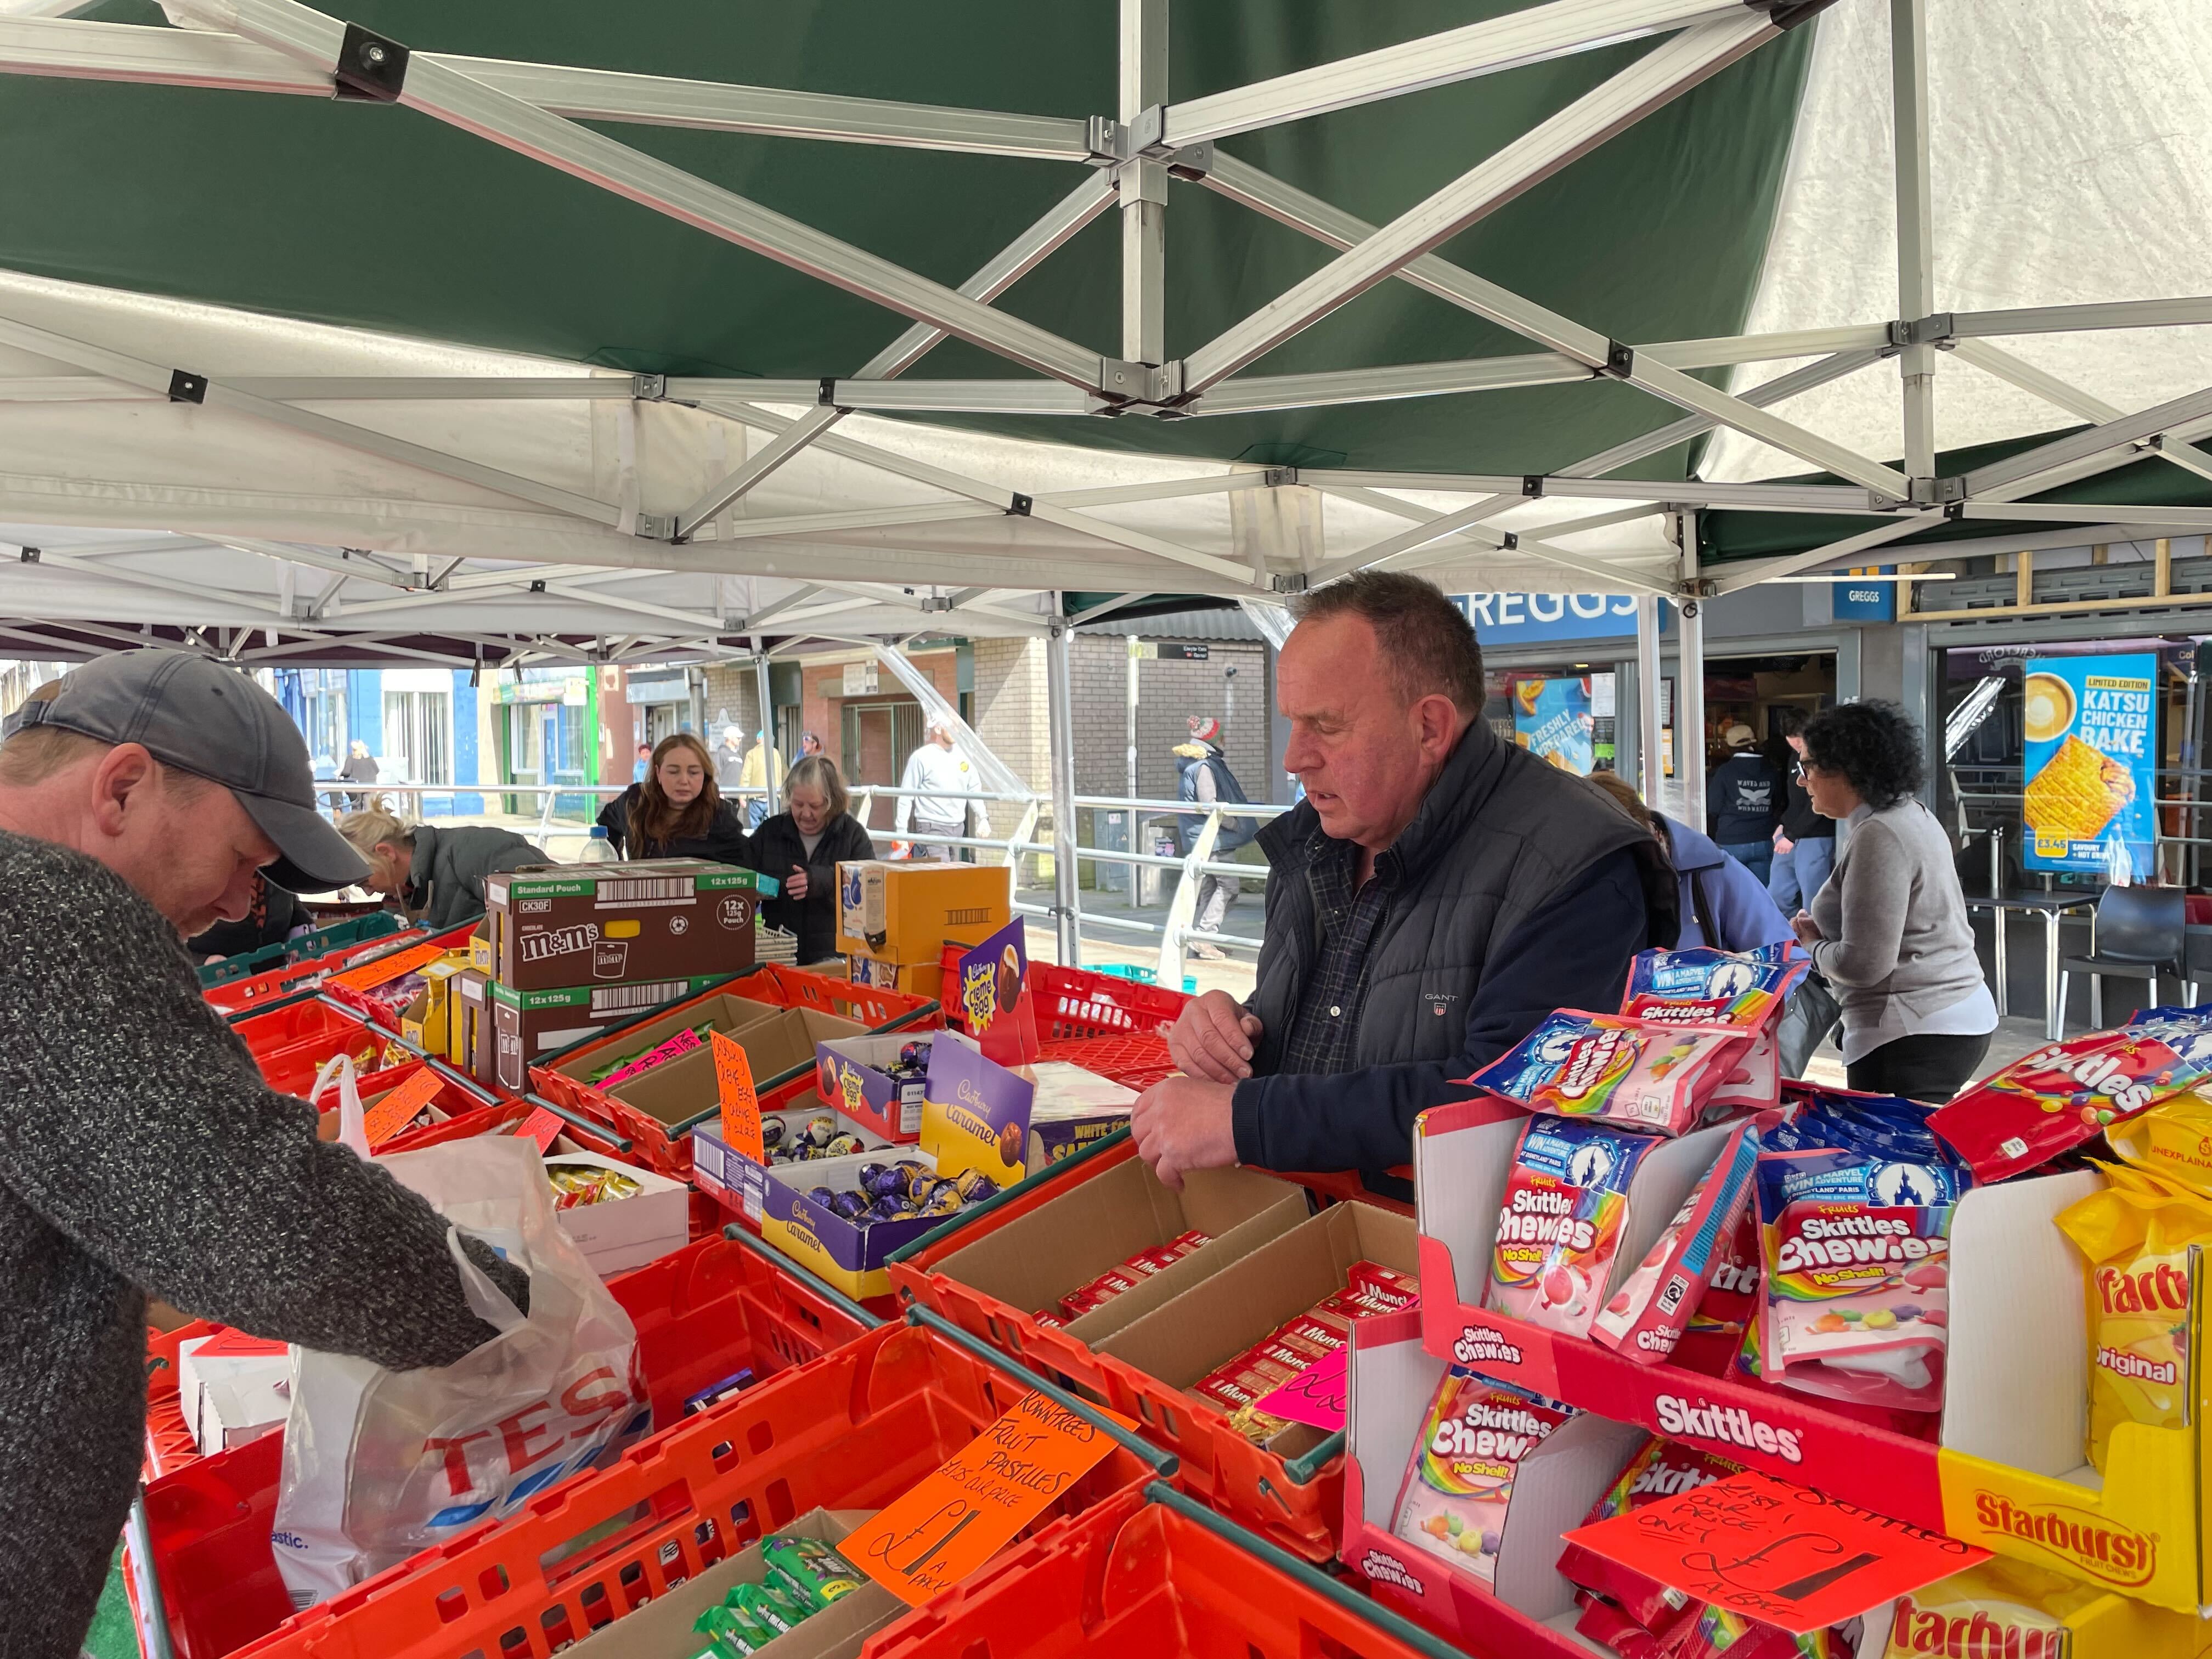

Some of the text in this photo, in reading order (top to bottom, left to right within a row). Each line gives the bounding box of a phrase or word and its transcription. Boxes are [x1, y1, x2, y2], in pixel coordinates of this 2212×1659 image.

[1849, 590, 1880, 602] GREGGS
[1464, 594, 1638, 627] REGGS
[2089, 678, 2148, 690] LIMITED EDITION
[2084, 690, 2149, 713] KATSU
[1530, 708, 1572, 746] FRESHLY
[2081, 710, 2147, 728] CHICKEN
[2080, 726, 2146, 754] BAKE
[2038, 839, 2066, 849] £3.45
[2072, 843, 2100, 851] SAVOURY
[517, 884, 582, 894] Standard Pouch
[521, 901, 549, 911] CK30F
[724, 900, 744, 911] 12x
[726, 910, 742, 918] 125g
[1657, 974, 1674, 987] WIN
[1681, 968, 1705, 977] MARVEL
[969, 980, 992, 1005] creme
[973, 998, 990, 1019] egg
[1641, 1005, 1717, 1020] Skittles
[843, 1077, 860, 1094] creme
[846, 1090, 857, 1103] egg
[957, 1080, 991, 1116] Cadbury
[947, 1104, 996, 1147] Caramel
[1075, 1122, 1107, 1139] WHITE
[1527, 1135, 1547, 1151] WIN
[1543, 1146, 1568, 1158] ADVENTURE
[1551, 1139, 1572, 1151] MARVEL
[1549, 1159, 1562, 1167] PARIS
[1530, 1175, 1557, 1188] Fruits
[1815, 1177, 1863, 1185] ADVENTURE
[1825, 1169, 1864, 1179] MARVEL
[1785, 1179, 1814, 1194] WIN
[1513, 1189, 1575, 1215] Skittles
[1818, 1204, 1859, 1215] Fruits
[792, 1200, 816, 1231] Cadbury
[786, 1220, 821, 1253] Caramel
[1496, 1210, 1596, 1250] Chewies
[1801, 1215, 1911, 1240] Skittles
[1503, 1249, 1519, 1262] No
[1778, 1237, 1948, 1272] Chewies
[1813, 1267, 1887, 1285] No Shell!
[2096, 1262, 2188, 1314] tarb
[1463, 1327, 1504, 1344] Skittles
[1454, 1340, 1522, 1364] Chewies
[1489, 1392, 1522, 1406] Fruits
[1465, 1403, 1552, 1438] Skittles
[1655, 1394, 1802, 1465] Skittles
[421, 1365, 639, 1497] TES
[984, 1418, 1048, 1452] FRUIT
[982, 1451, 1071, 1494] PASTILLES
[1453, 1463, 1509, 1479] No Shell!
[964, 1476, 992, 1500] OUR
[984, 1487, 1023, 1508] PRICE
[1688, 1494, 1752, 1518] OUR
[868, 1499, 981, 1576] £1
[1638, 1515, 1716, 1544] ONLY
[1975, 1492, 2149, 1571] Starburst
[929, 1560, 947, 1572] A
[1369, 1549, 1406, 1573] Skittles
[1681, 1532, 1883, 1601] £1
[2080, 1555, 2137, 1580] FRUIT CHEWS
[907, 1572, 952, 1595] PACK
[1362, 1559, 1424, 1594] Chewies
[1690, 1581, 1727, 1594] A
